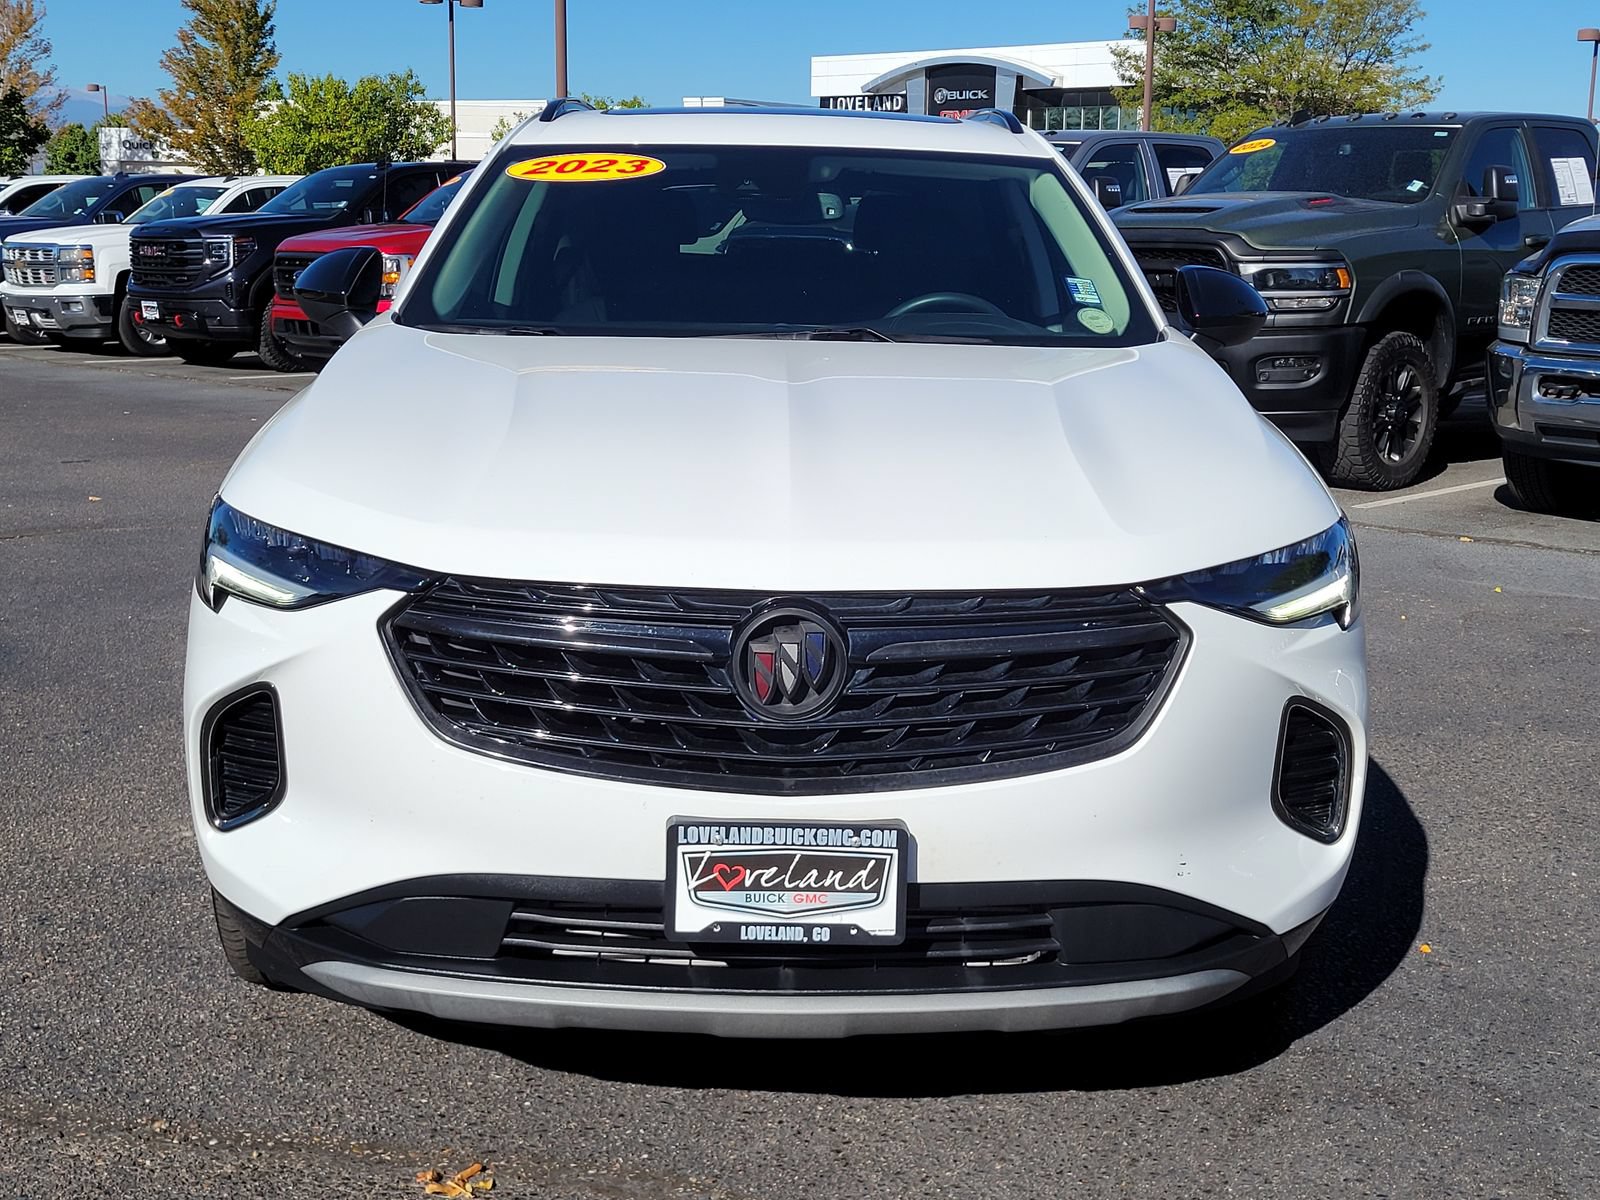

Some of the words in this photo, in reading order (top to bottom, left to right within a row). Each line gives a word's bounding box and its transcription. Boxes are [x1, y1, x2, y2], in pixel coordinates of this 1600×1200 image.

[947, 89, 989, 100] BUICK
[829, 95, 903, 111] LOVELAND
[122, 139, 156, 150] Quick
[521, 159, 651, 175] 2023
[744, 893, 785, 904] BUICK
[792, 893, 829, 904] GMC
[740, 926, 809, 943] LOVELAND,
[812, 927, 830, 942] CO
